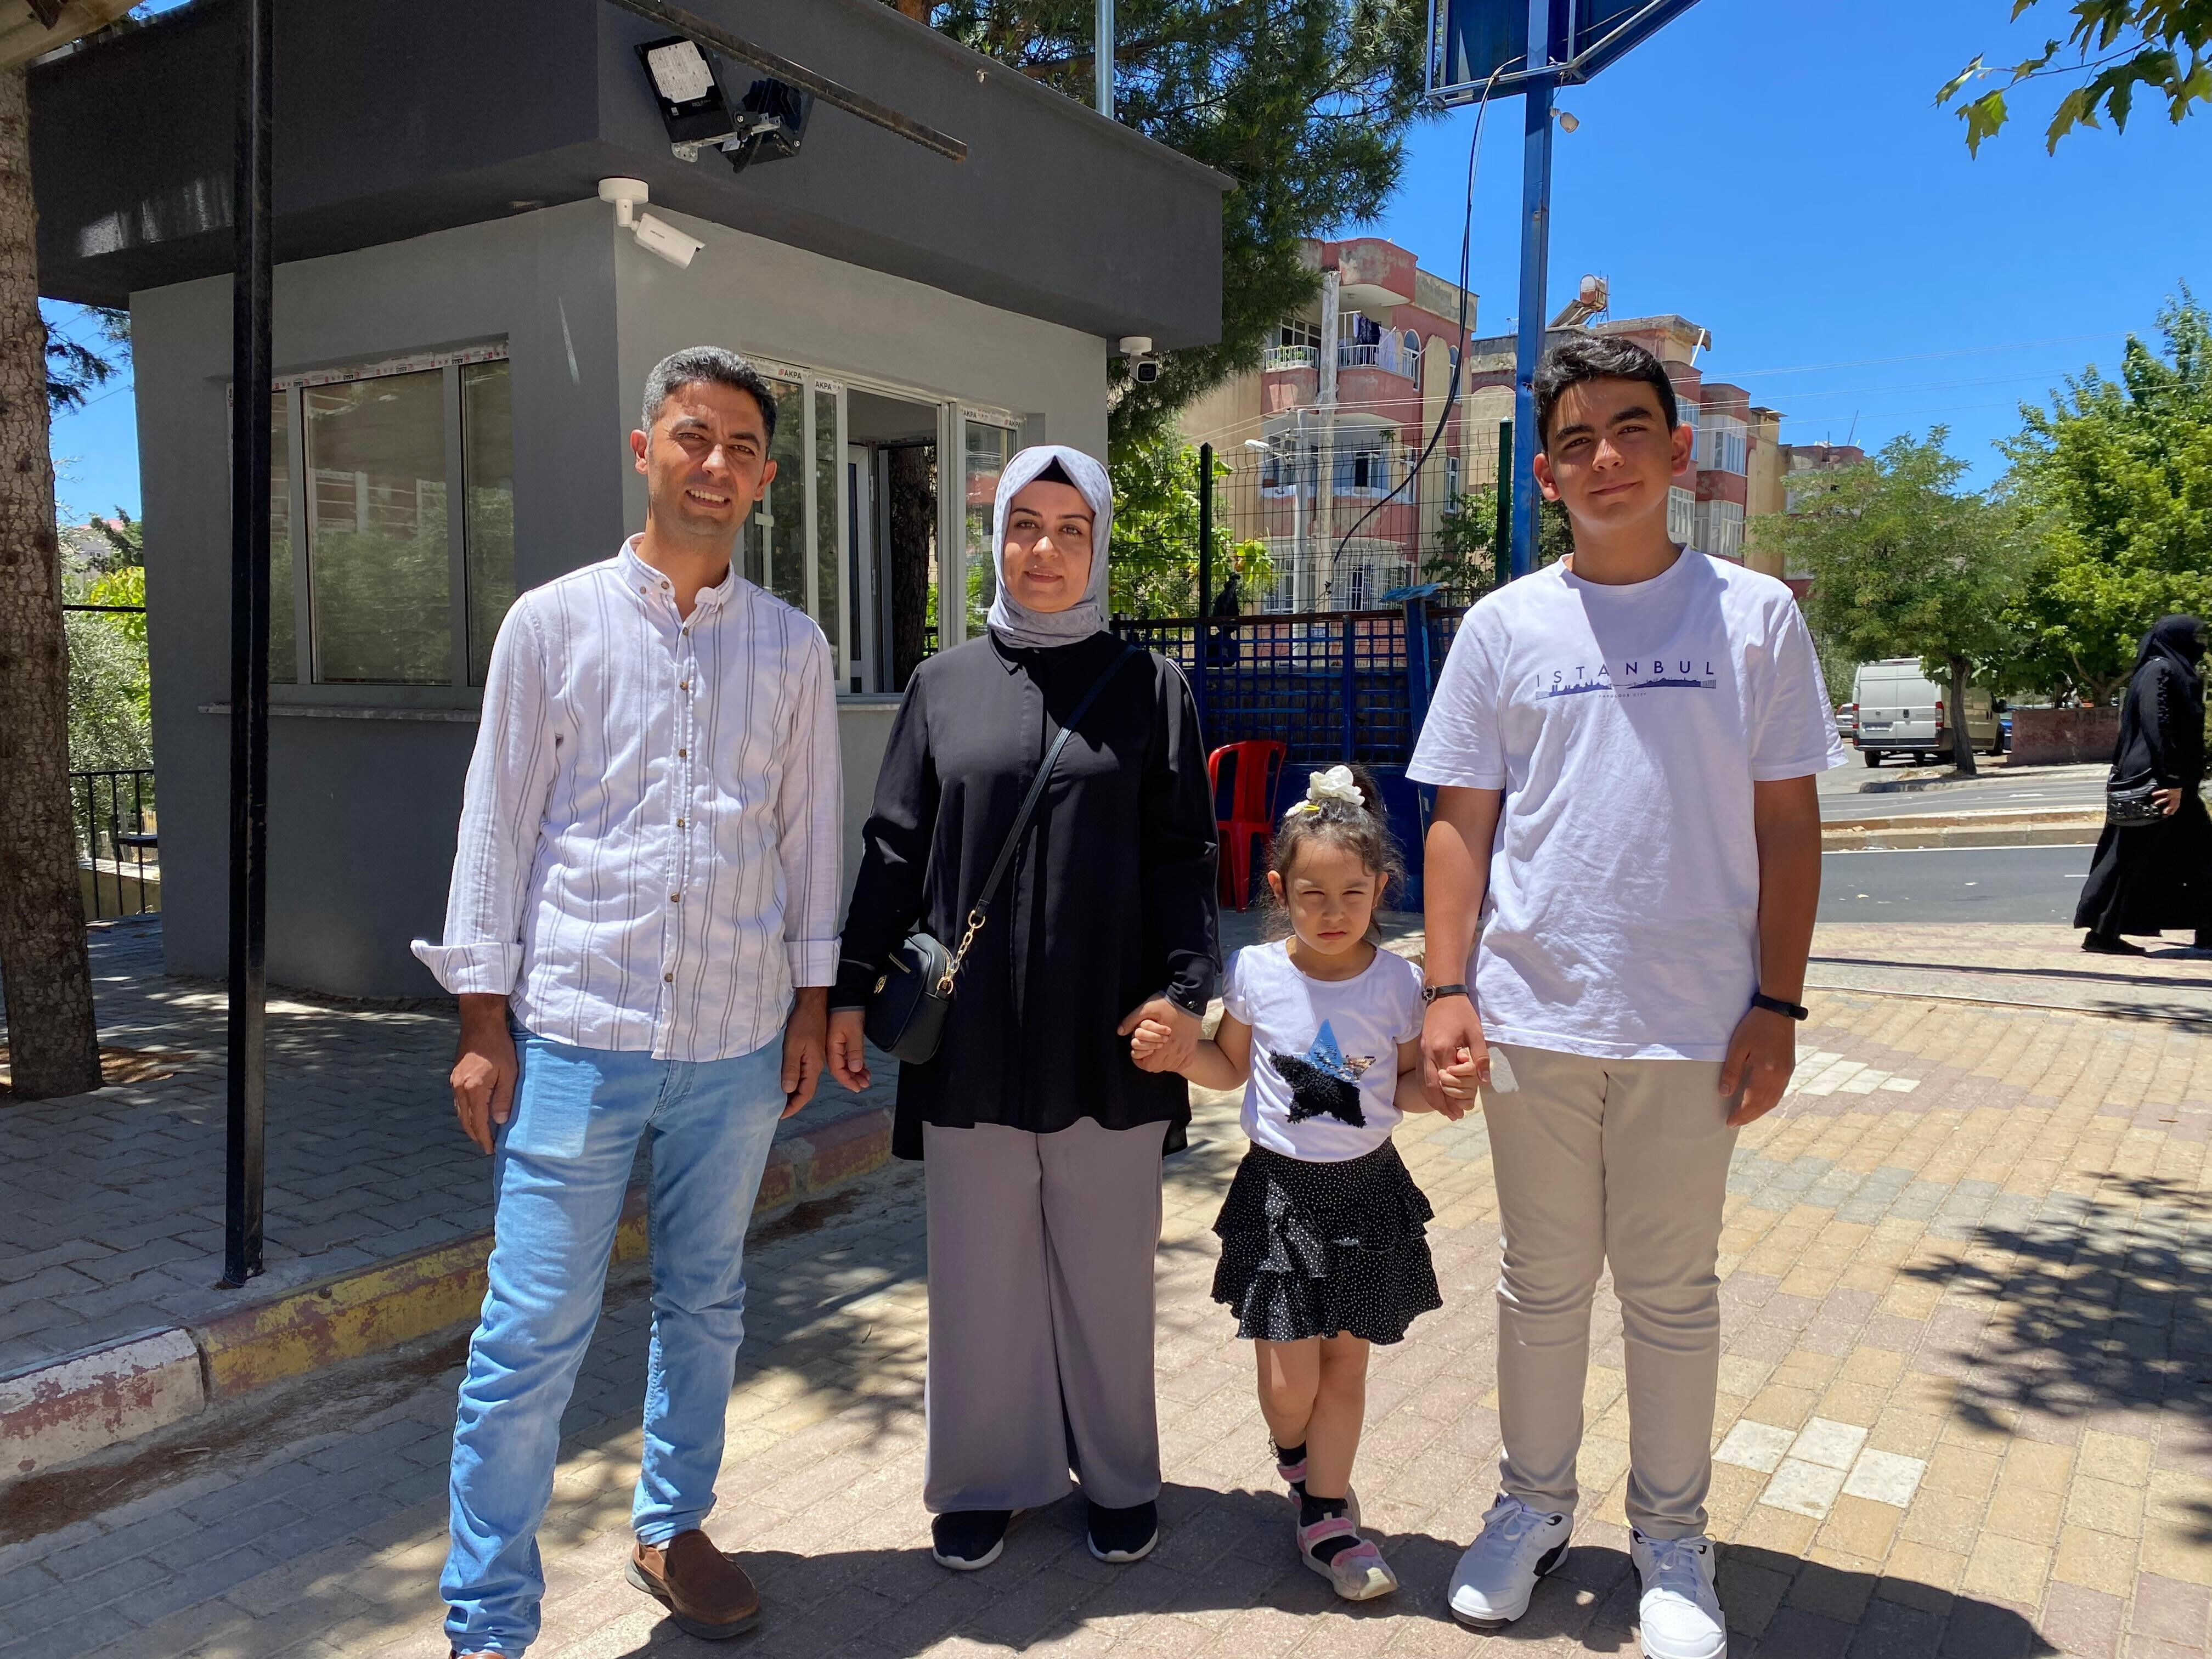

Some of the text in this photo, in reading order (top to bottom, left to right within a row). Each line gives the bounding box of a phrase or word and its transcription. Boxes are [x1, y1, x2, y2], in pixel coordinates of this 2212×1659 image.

[784, 369, 803, 380] AKPA
[815, 380, 832, 391] AKPA
[963, 410, 978, 419] AKPA
[1537, 661, 1714, 687] ISTANBUL
